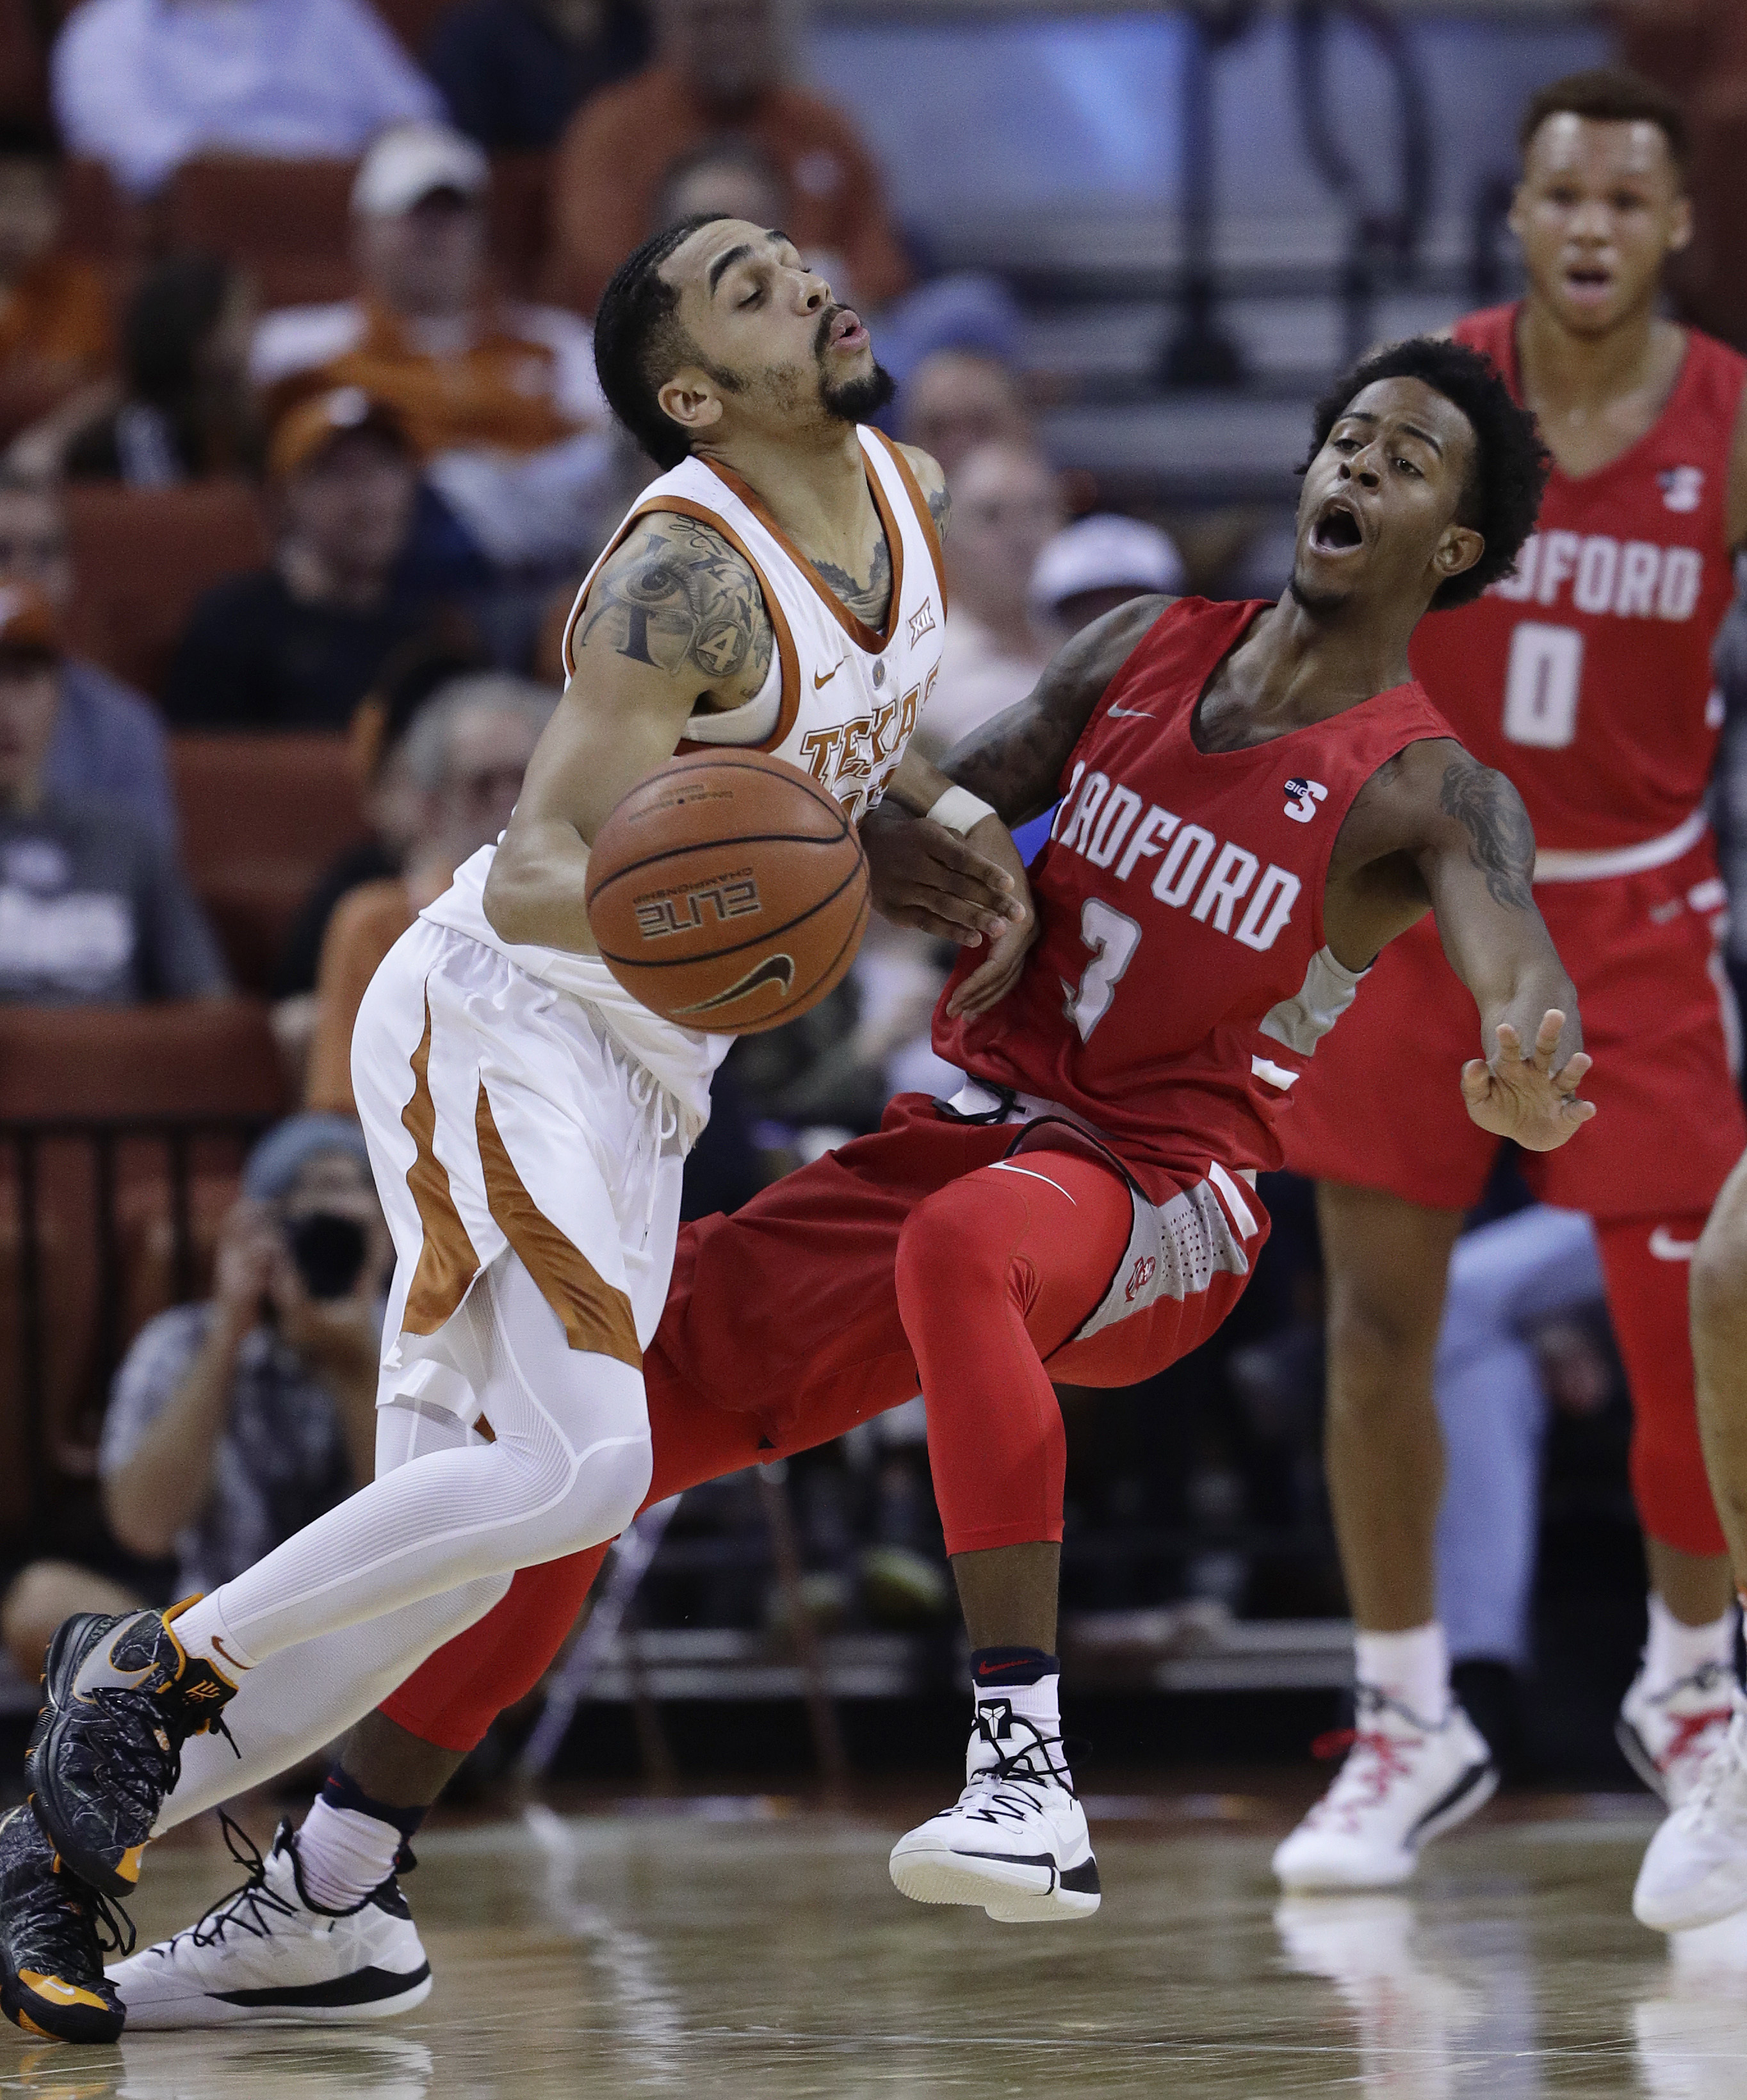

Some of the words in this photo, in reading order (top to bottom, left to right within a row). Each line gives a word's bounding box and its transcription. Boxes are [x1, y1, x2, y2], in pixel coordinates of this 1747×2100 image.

[697, 626, 738, 673] 4
[1505, 621, 1584, 748] 0
[1285, 779, 1308, 798] BIG
[635, 878, 761, 939] ELITE
